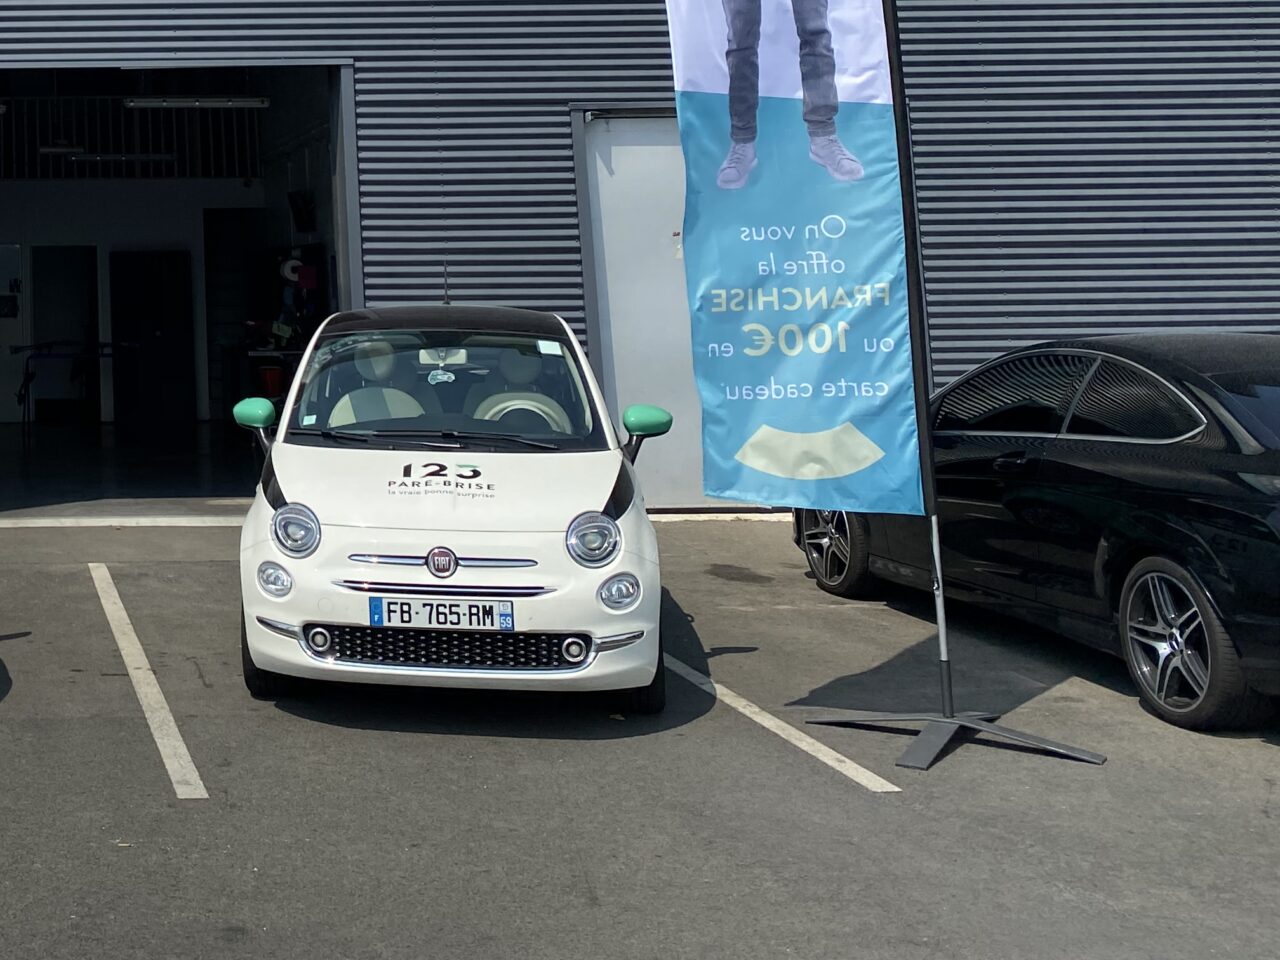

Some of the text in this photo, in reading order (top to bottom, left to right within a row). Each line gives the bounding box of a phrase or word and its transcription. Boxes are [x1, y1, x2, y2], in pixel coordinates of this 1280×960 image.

[403, 463, 482, 479] 123
[387, 480, 496, 491] PARE-BRISE
[433, 556, 450, 569] FIAT
[374, 614, 379, 622] F
[500, 617, 513, 628] 59
